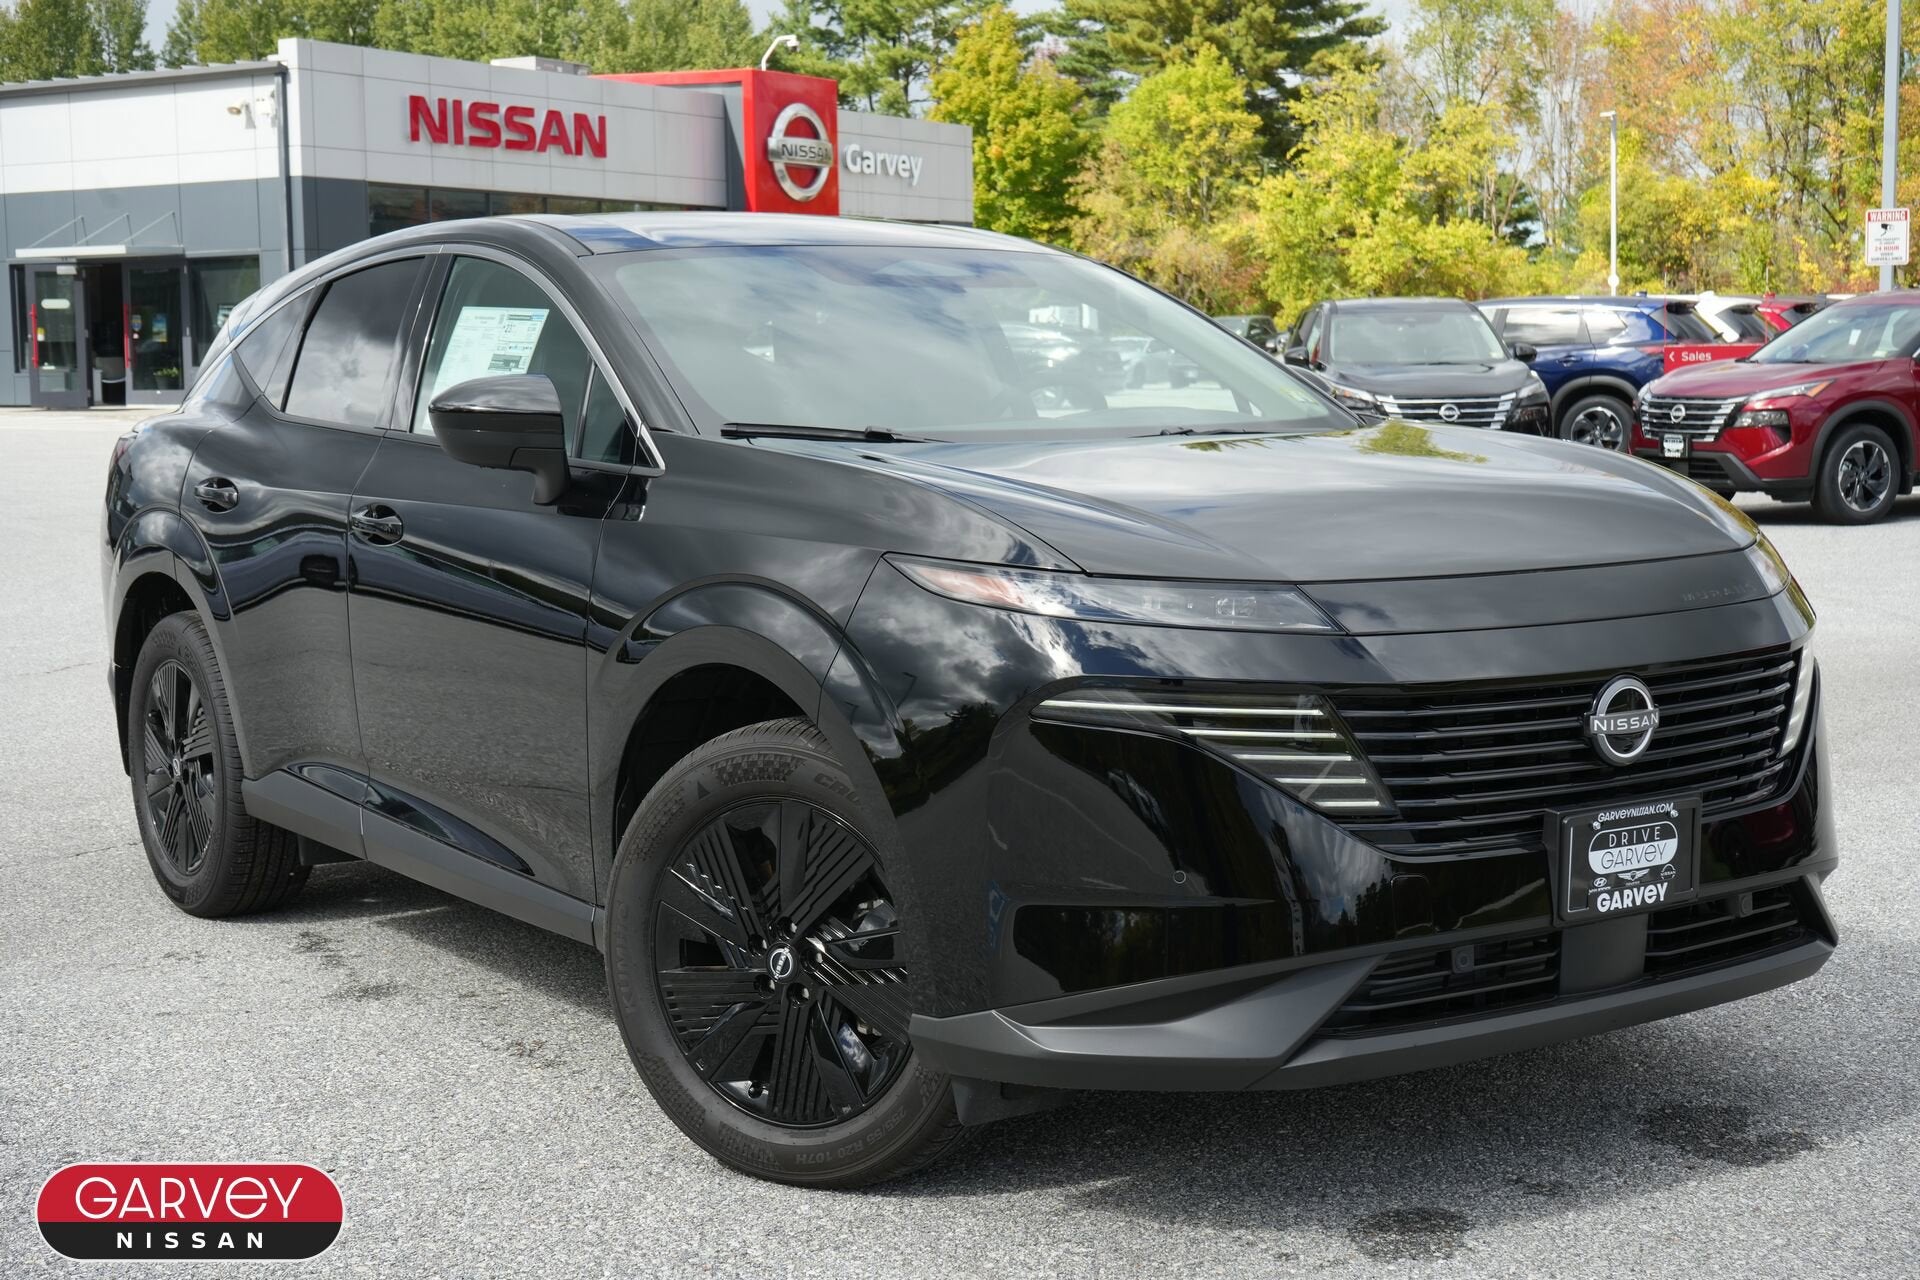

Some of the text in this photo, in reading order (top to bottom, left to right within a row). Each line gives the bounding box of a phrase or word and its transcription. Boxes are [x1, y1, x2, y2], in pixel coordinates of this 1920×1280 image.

[409, 94, 608, 158] NISSAN
[845, 143, 923, 186] Garvey
[1871, 211, 1905, 222] WARNING
[1681, 351, 1712, 362] Sales
[1594, 712, 1659, 731] NISSAN
[1609, 826, 1661, 848] DRIVE
[795, 1151, 832, 1166] 107H
